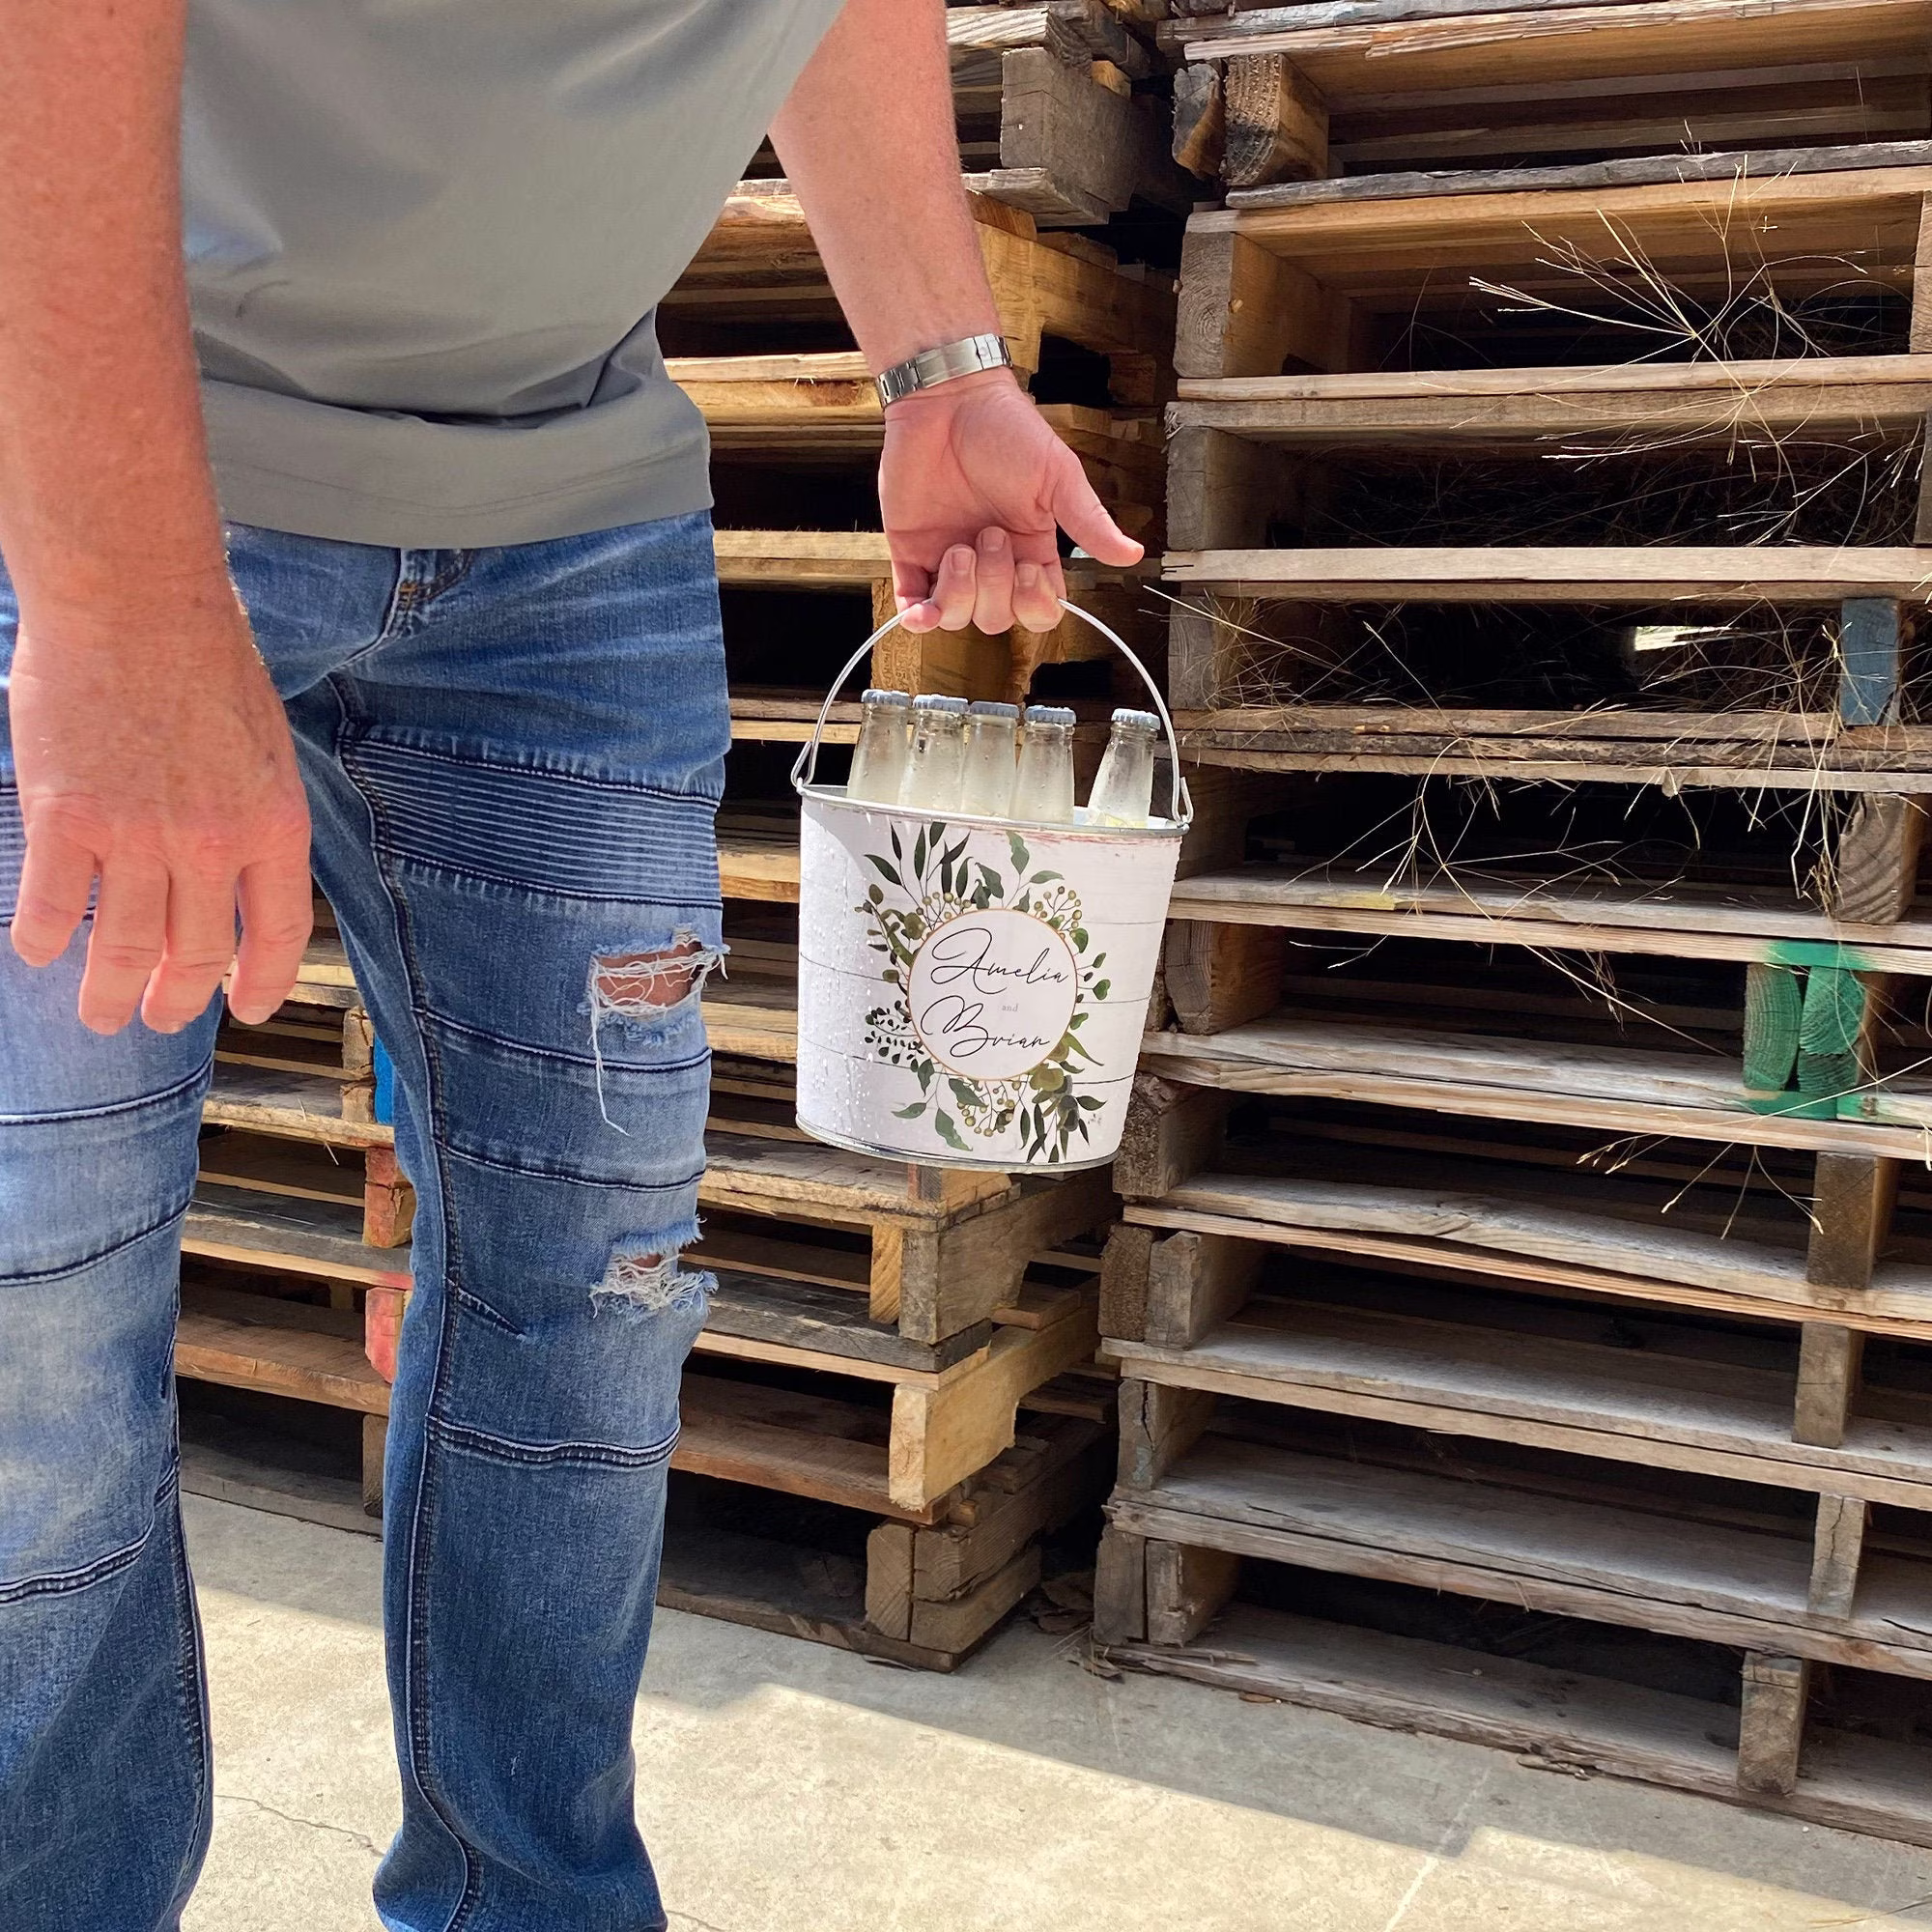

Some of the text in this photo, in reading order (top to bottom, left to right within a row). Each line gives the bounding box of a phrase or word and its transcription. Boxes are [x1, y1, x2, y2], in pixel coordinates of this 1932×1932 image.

[930, 927, 1069, 995] Amelia
[920, 995, 1051, 1058] Brian
[1001, 1004, 1019, 1012] and
